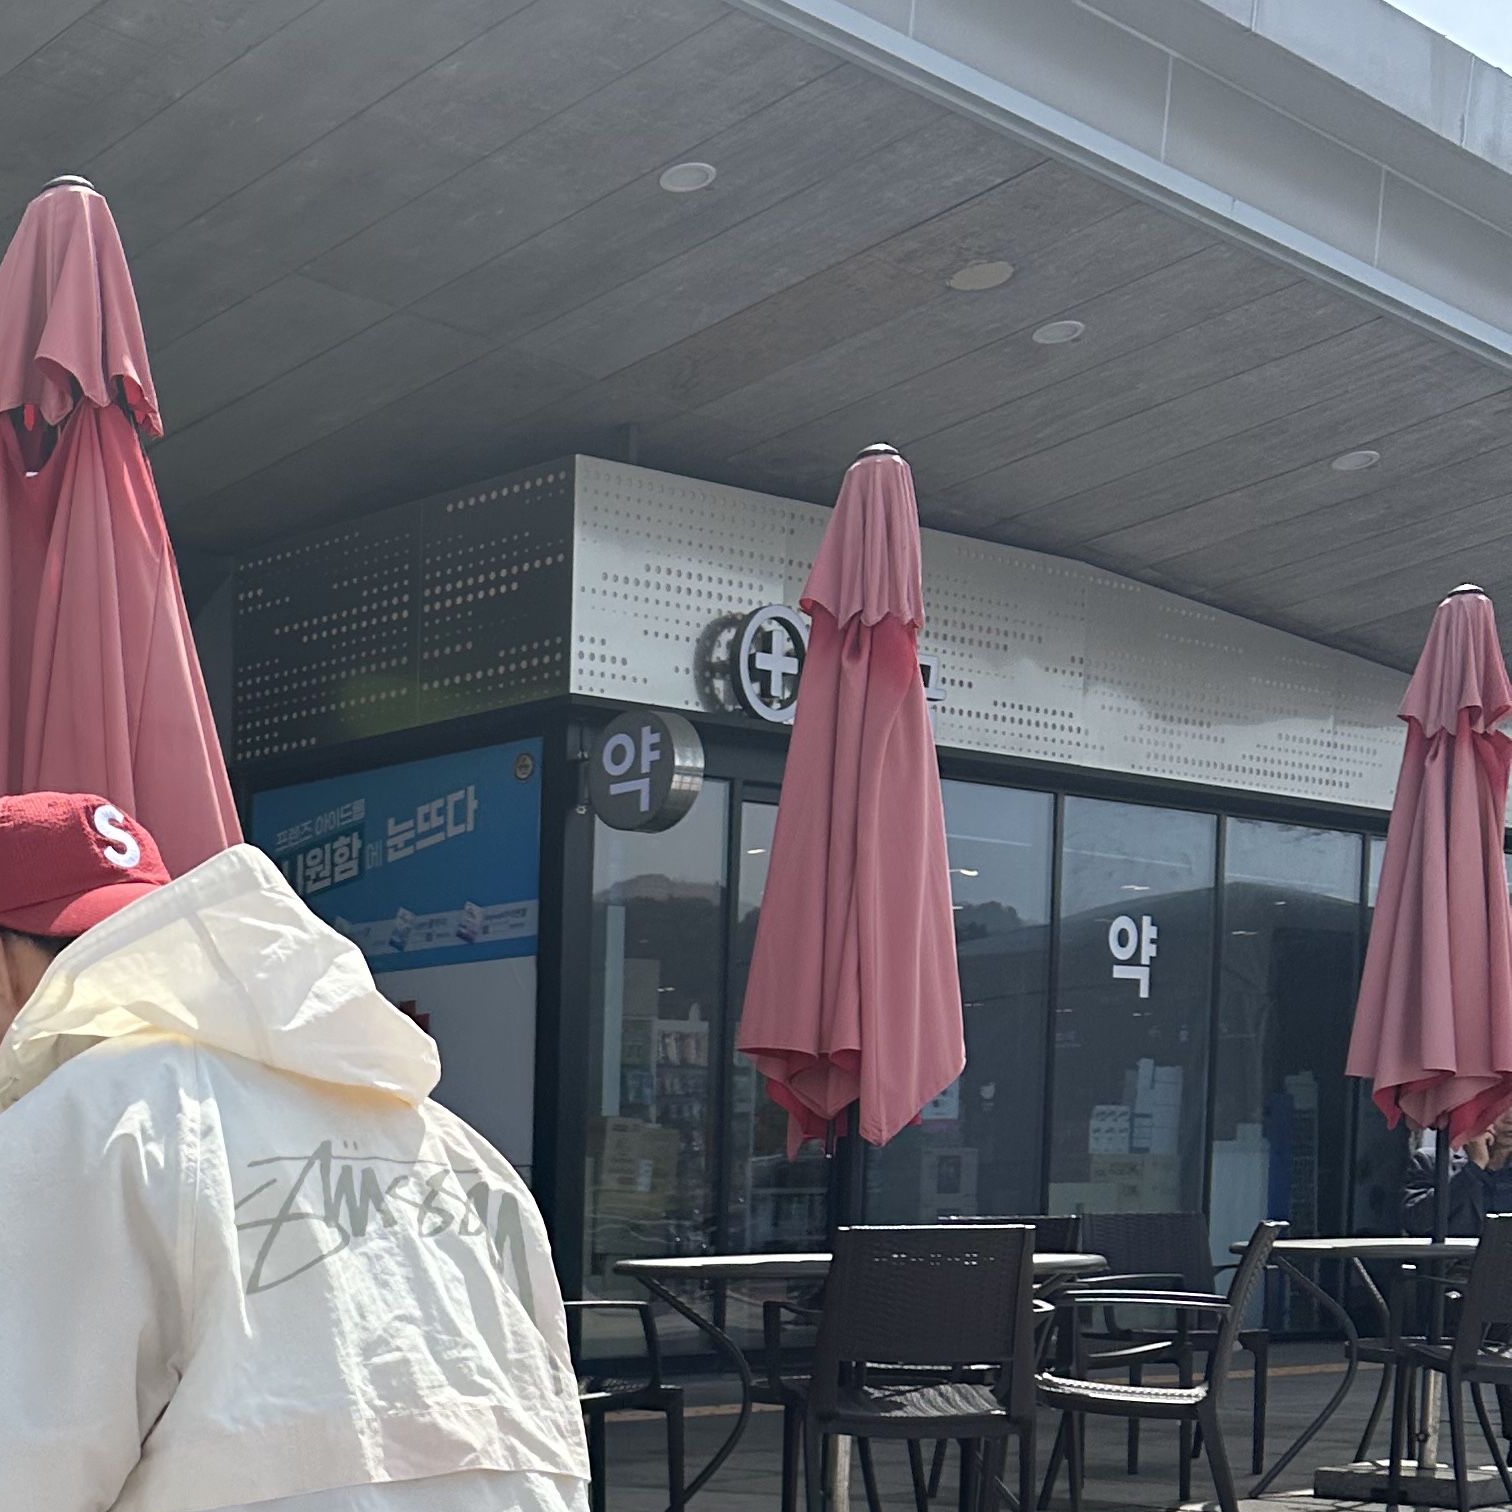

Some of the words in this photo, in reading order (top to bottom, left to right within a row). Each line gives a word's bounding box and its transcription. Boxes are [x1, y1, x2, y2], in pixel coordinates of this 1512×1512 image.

[602, 724, 662, 813] 약
[93, 804, 141, 868] S
[387, 785, 478, 864] 눈뜨다
[1108, 914, 1159, 999] 약
